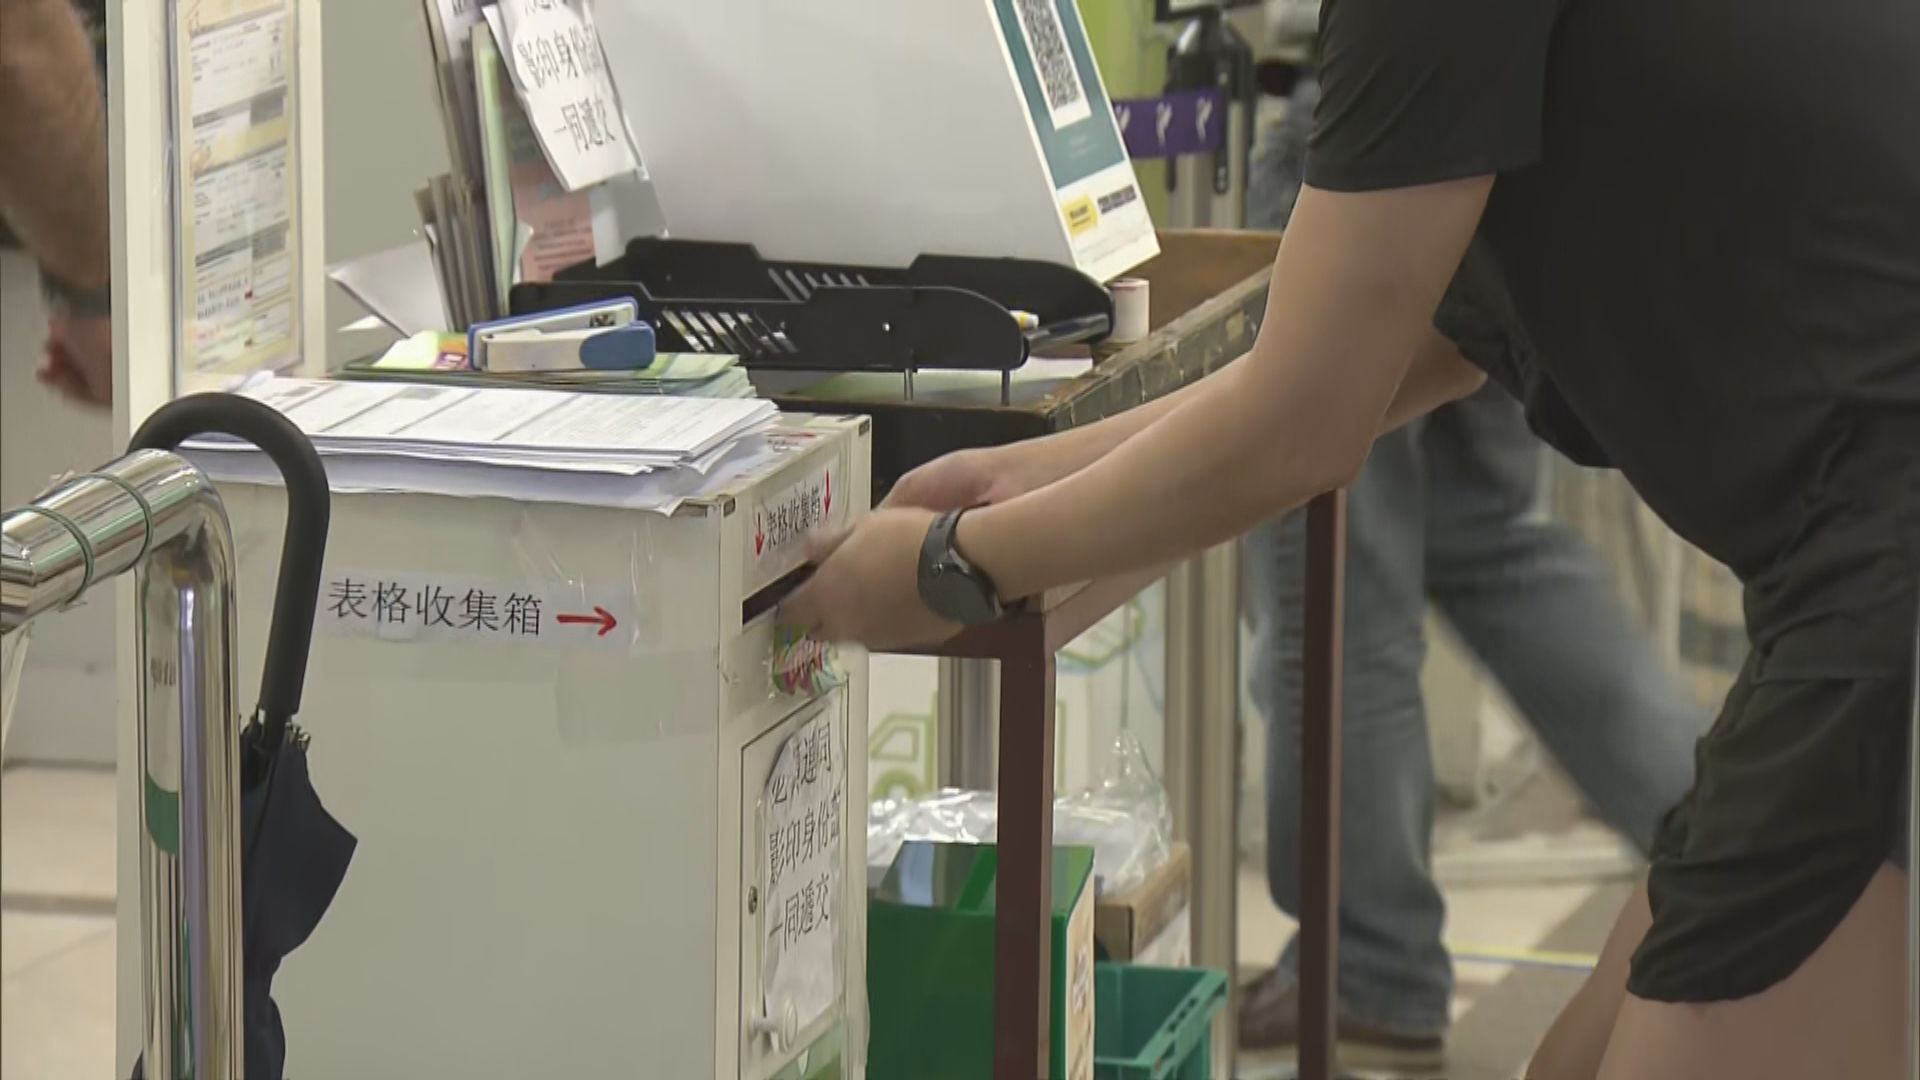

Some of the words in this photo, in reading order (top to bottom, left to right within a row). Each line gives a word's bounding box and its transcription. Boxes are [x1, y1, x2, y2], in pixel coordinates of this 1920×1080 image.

[554, 93, 616, 153] 一同遞交
[766, 484, 821, 550] 表格收集箱
[327, 577, 543, 637] 表格收集箱
[769, 872, 830, 953] 一同遞交
